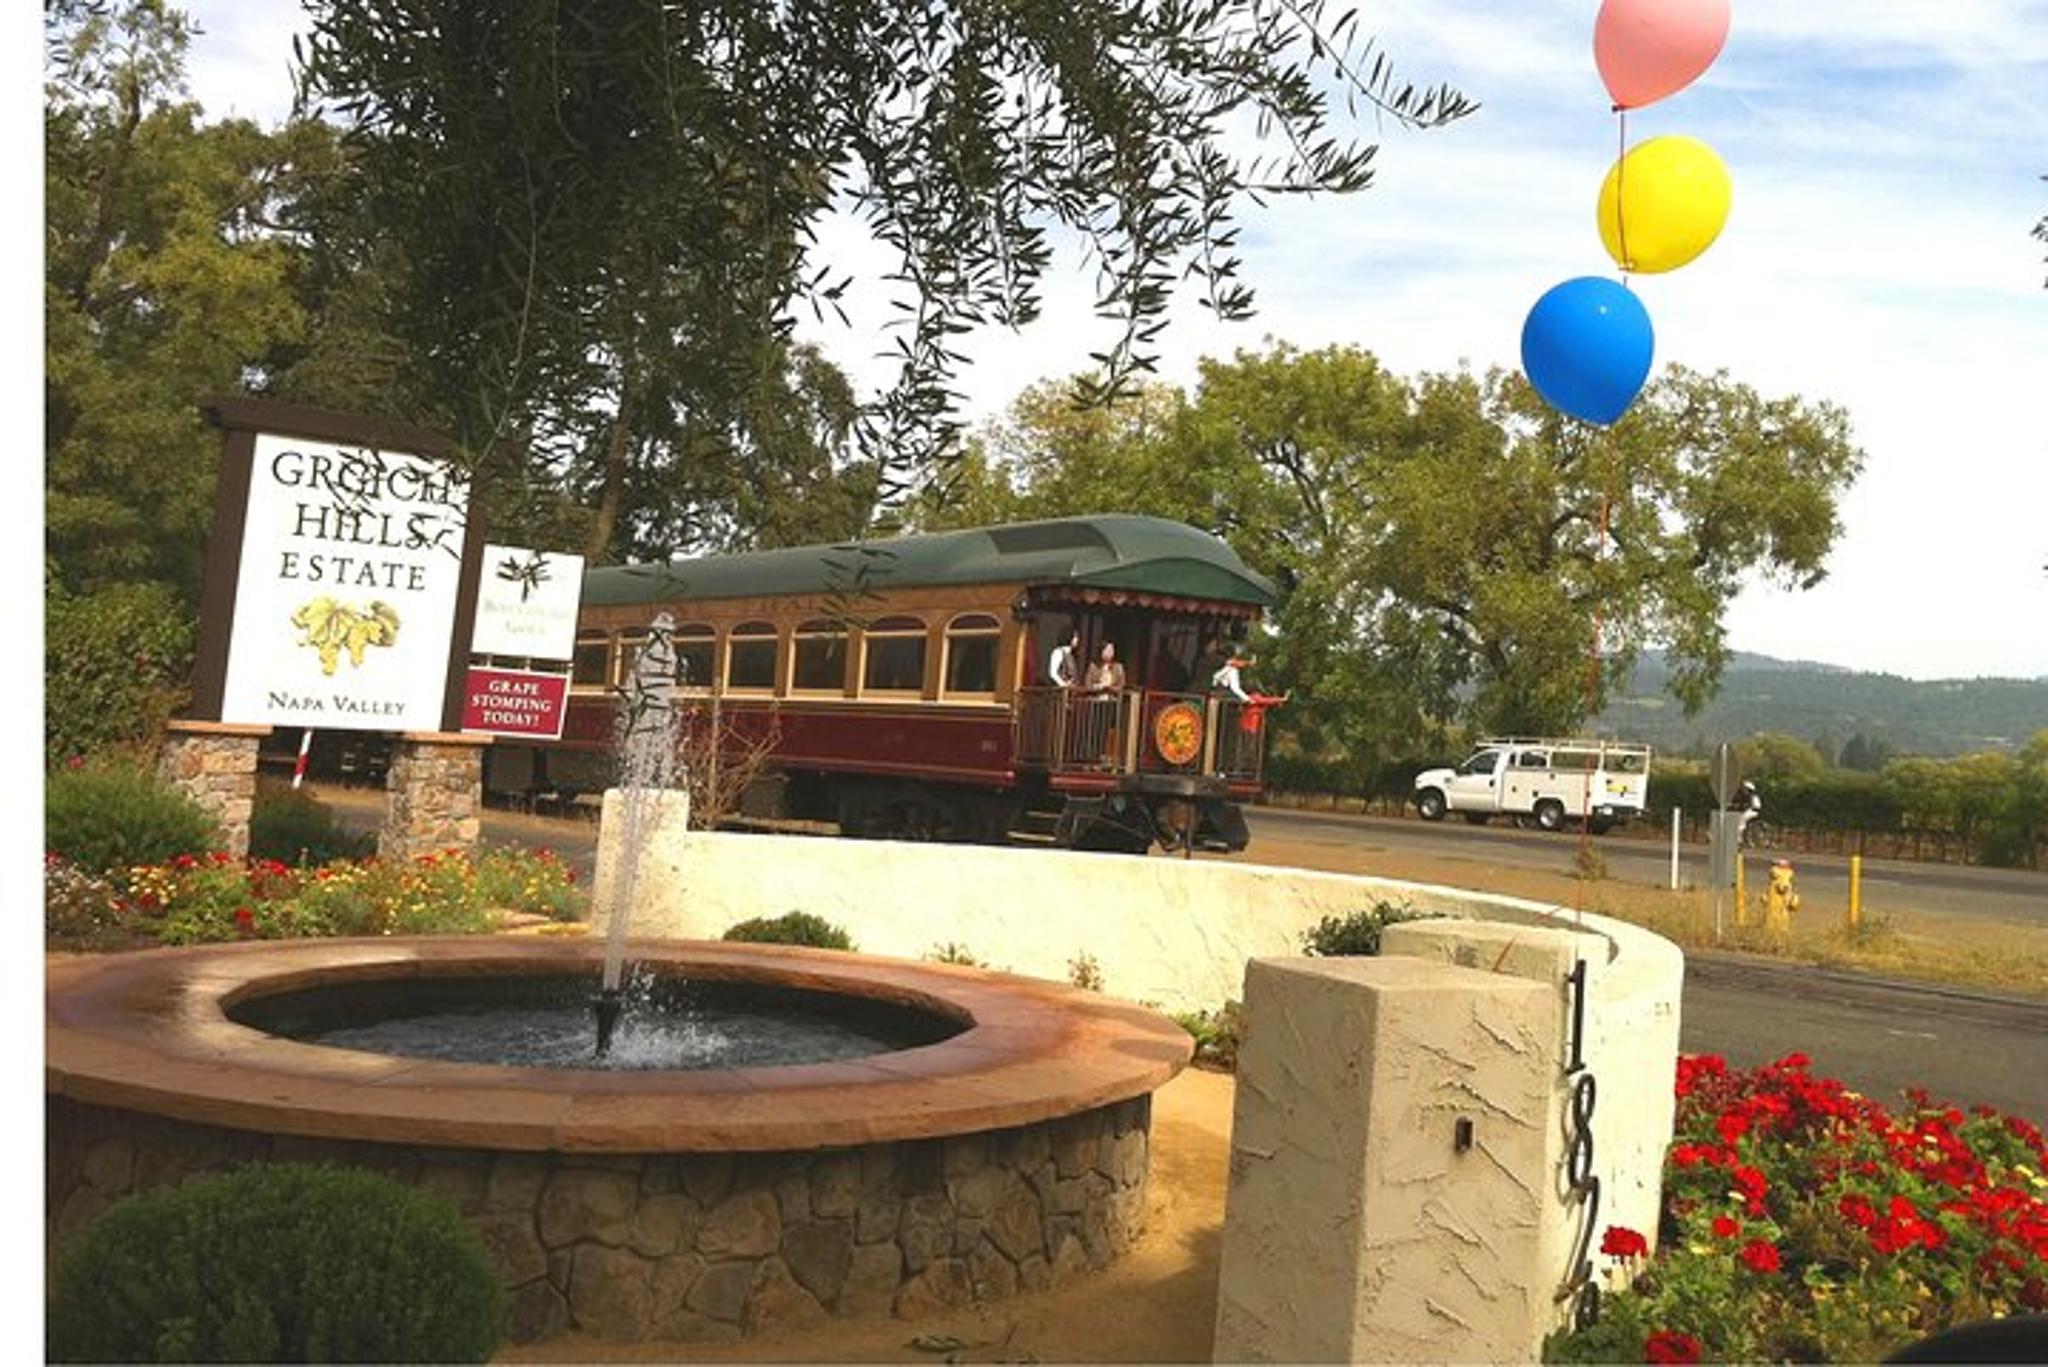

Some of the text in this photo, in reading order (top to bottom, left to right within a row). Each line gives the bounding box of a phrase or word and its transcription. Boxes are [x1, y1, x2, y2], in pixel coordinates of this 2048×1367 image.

[292, 502, 427, 550] HILLS
[279, 552, 426, 590] ESTATE
[489, 680, 540, 695] GRAPE
[472, 693, 554, 712] STOMPING
[483, 711, 541, 728] TODAY!
